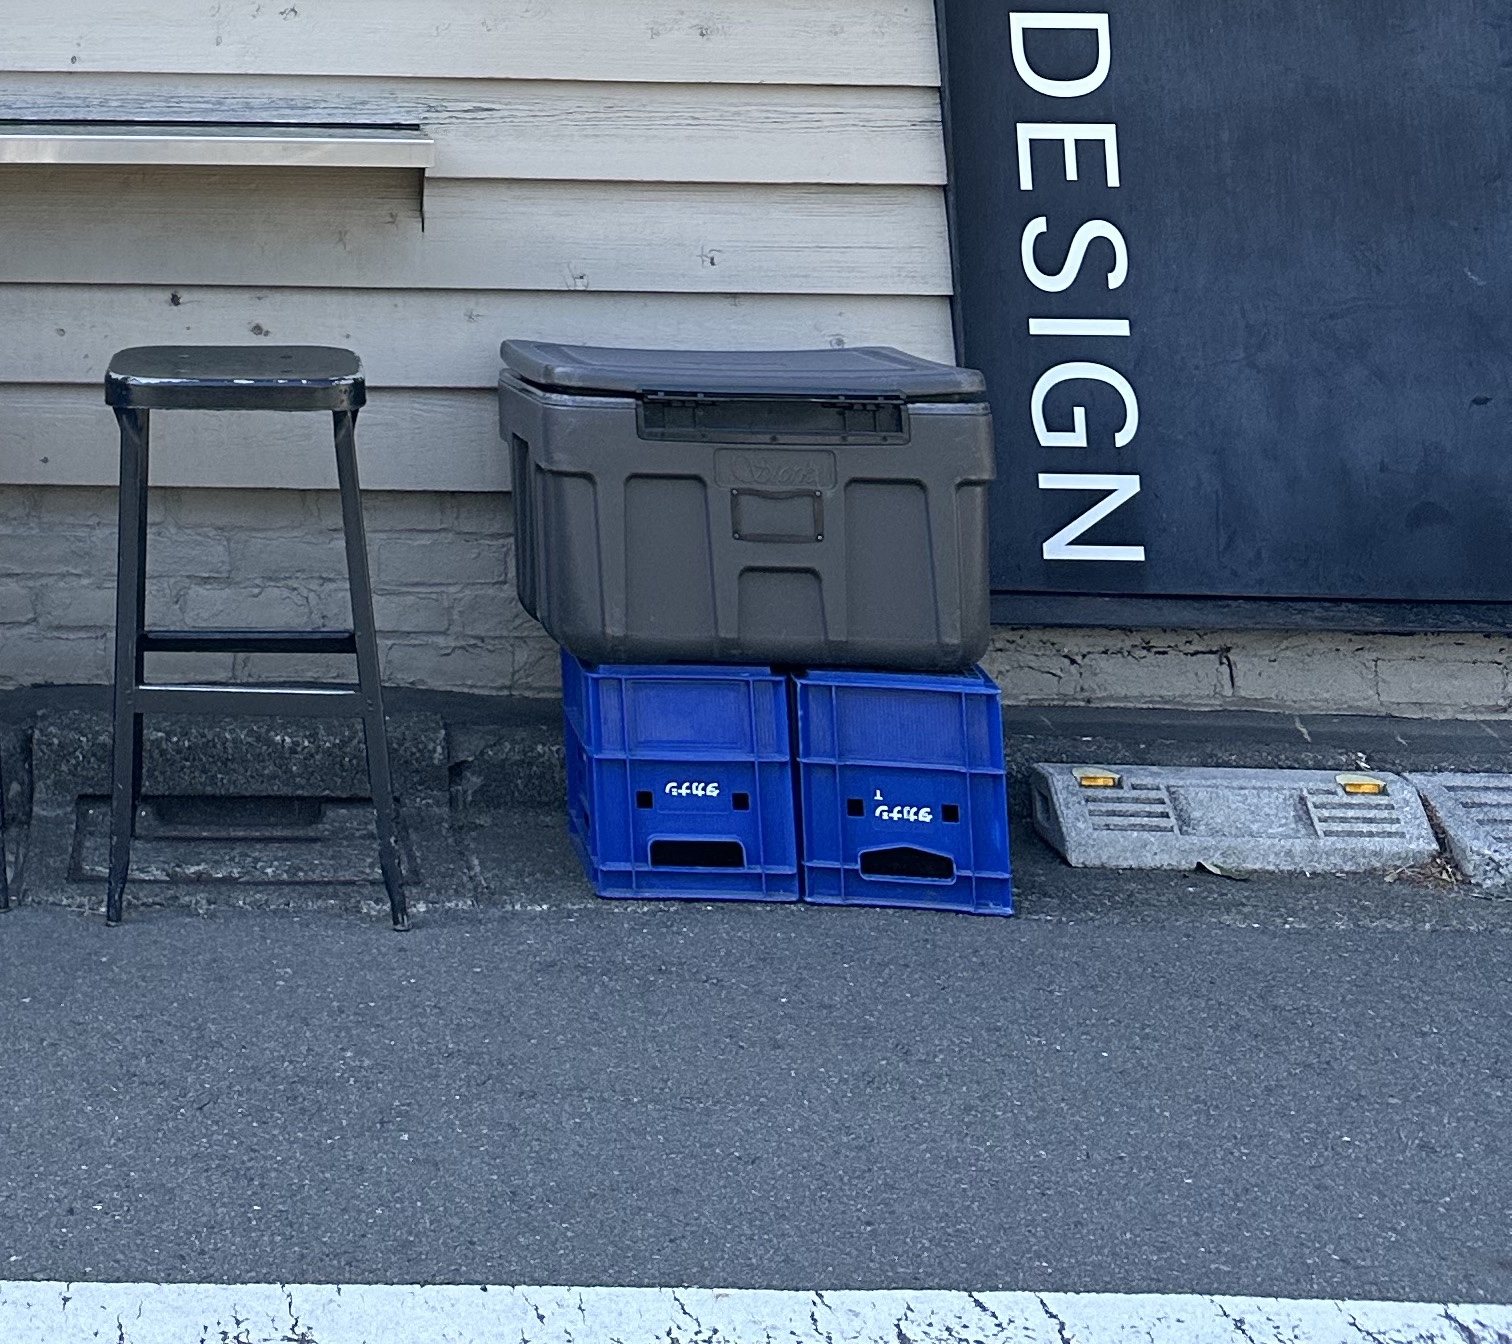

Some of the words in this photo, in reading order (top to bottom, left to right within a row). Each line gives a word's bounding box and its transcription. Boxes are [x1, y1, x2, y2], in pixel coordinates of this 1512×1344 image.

[1009, 12, 1145, 561] DESIGN
[665, 782, 720, 796] タカナシ
[875, 806, 933, 822] タカナシ
